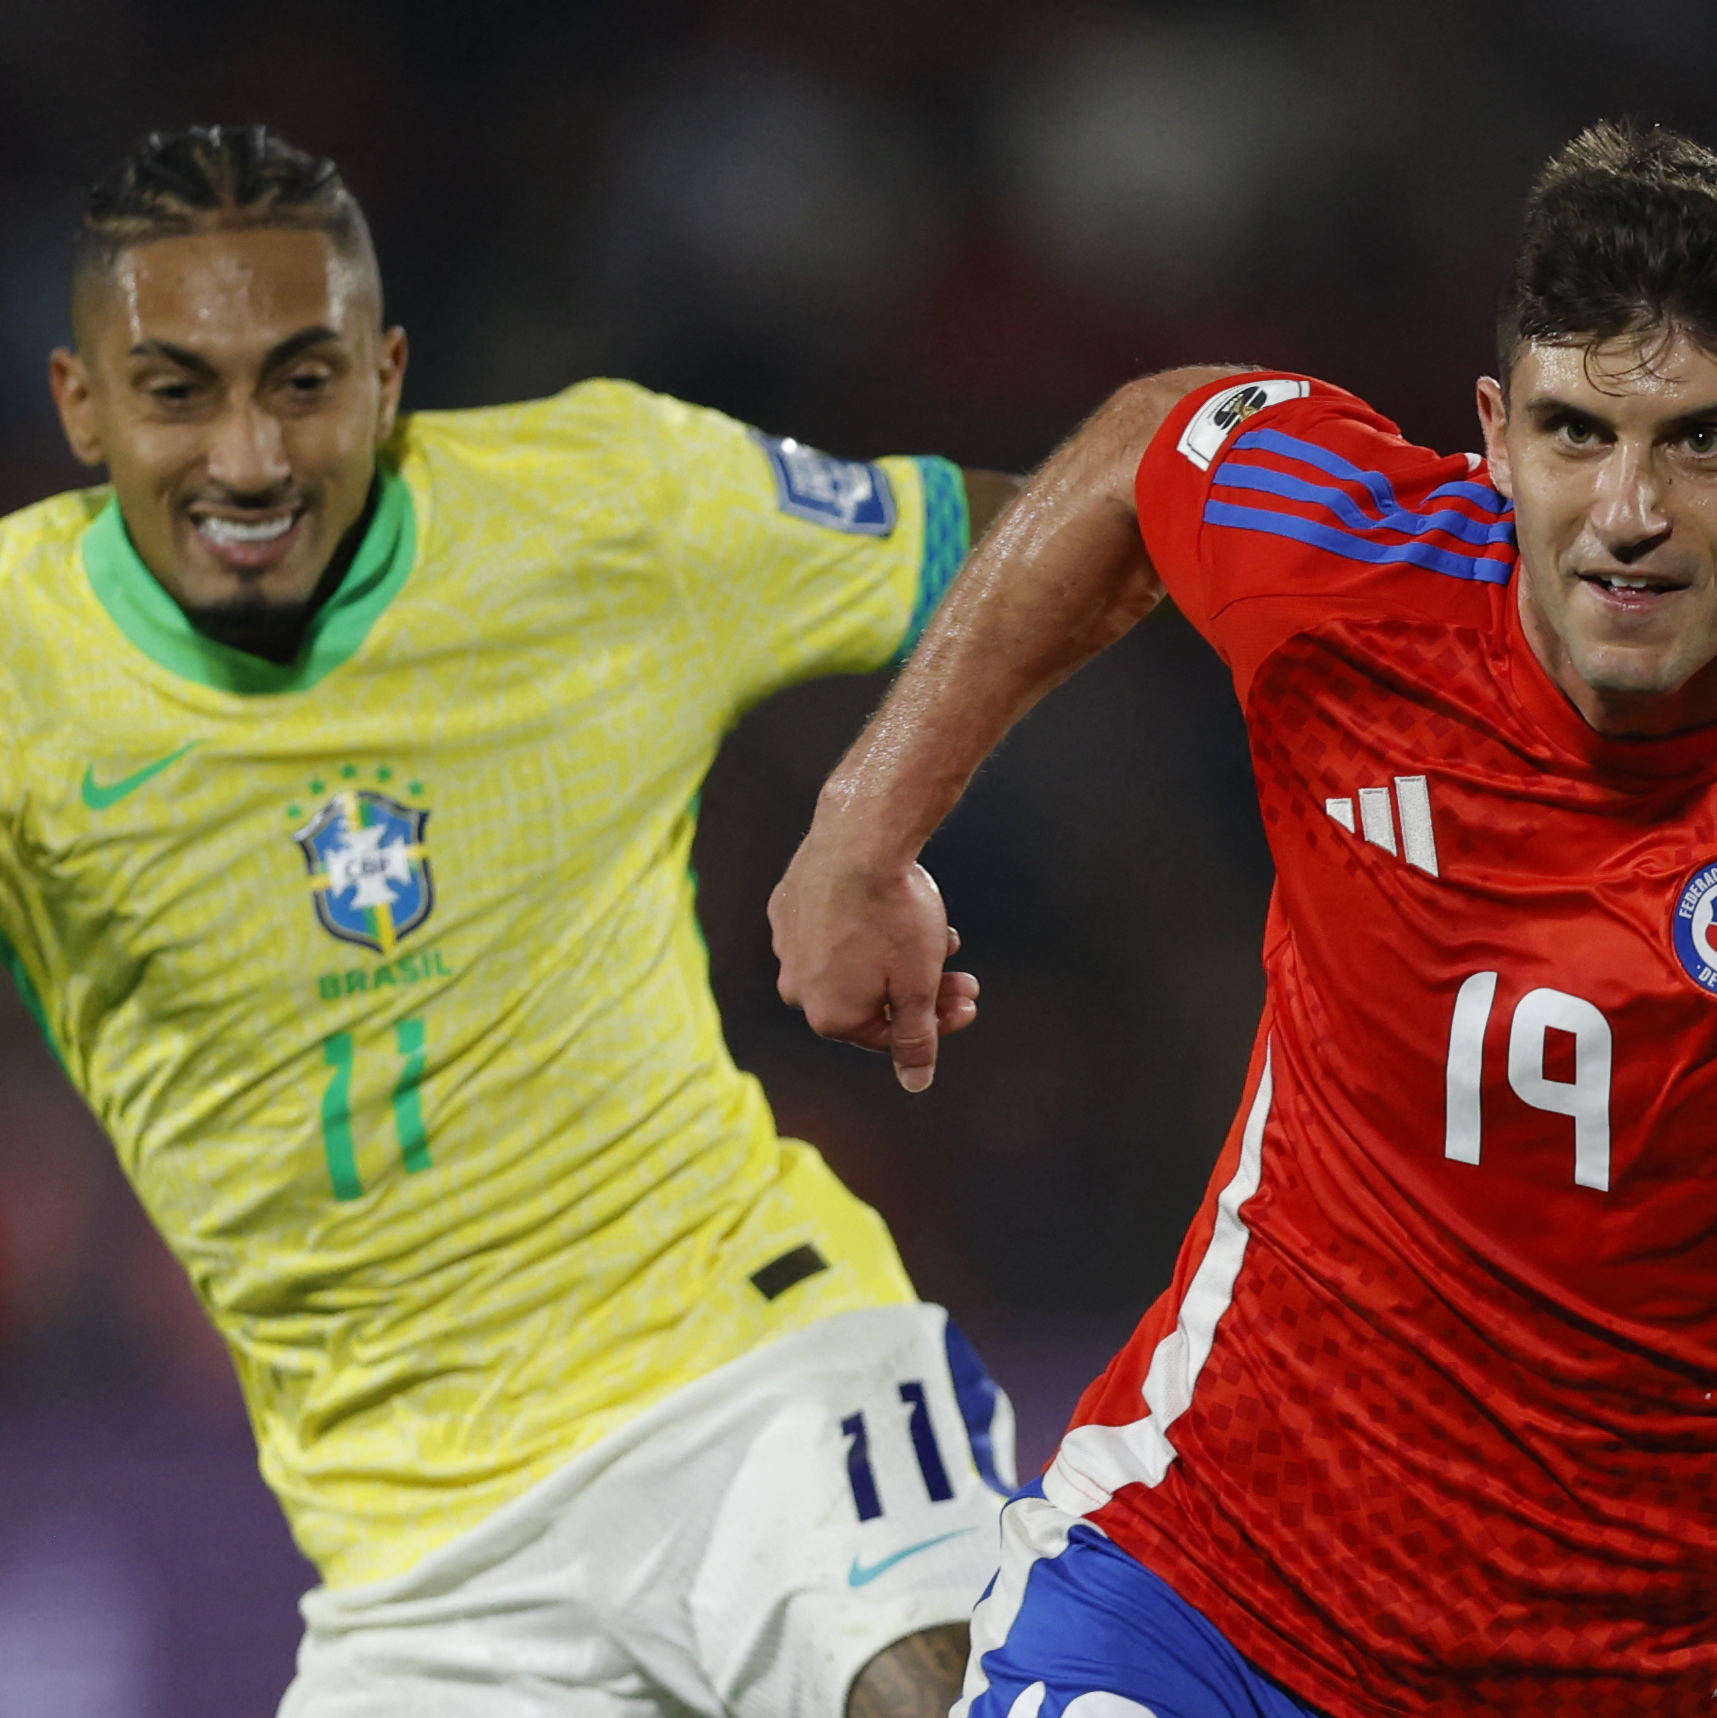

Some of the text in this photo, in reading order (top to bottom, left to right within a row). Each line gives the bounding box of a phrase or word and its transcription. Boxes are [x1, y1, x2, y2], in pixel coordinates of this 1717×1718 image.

[319, 950, 453, 1001] BRASIL
[323, 1018, 433, 1201] 11
[1444, 970, 1613, 1192] 19
[842, 1380, 957, 1522] 11
